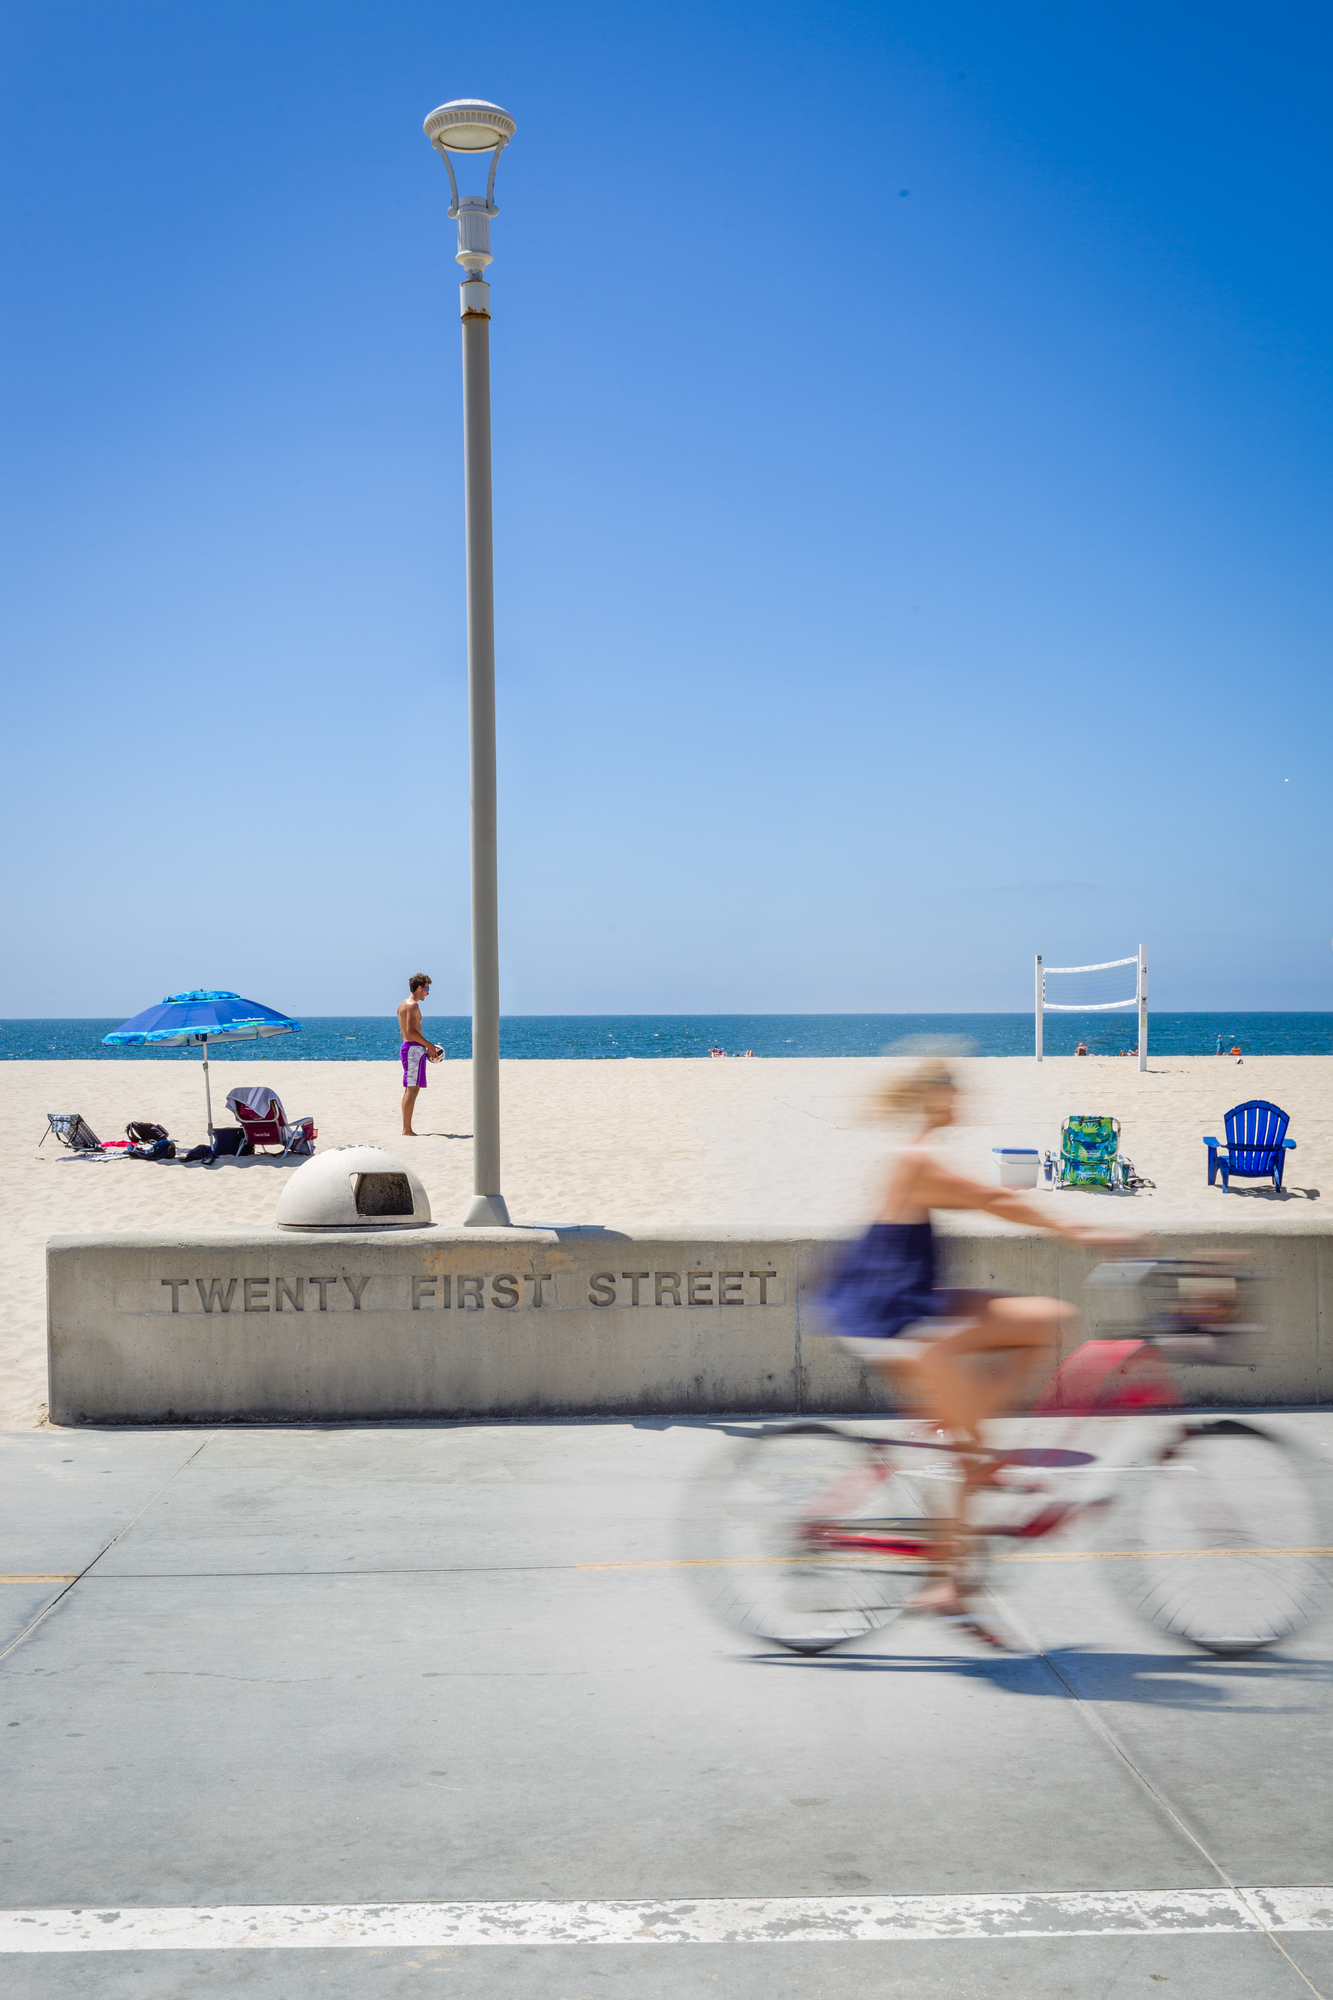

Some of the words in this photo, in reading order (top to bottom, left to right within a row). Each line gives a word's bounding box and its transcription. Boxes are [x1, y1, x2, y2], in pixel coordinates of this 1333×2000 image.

[1141, 966, 1147, 974] 4
[161, 1277, 371, 1313] TWENTY
[411, 1274, 552, 1311] FIRST
[588, 1270, 777, 1308] STREET
